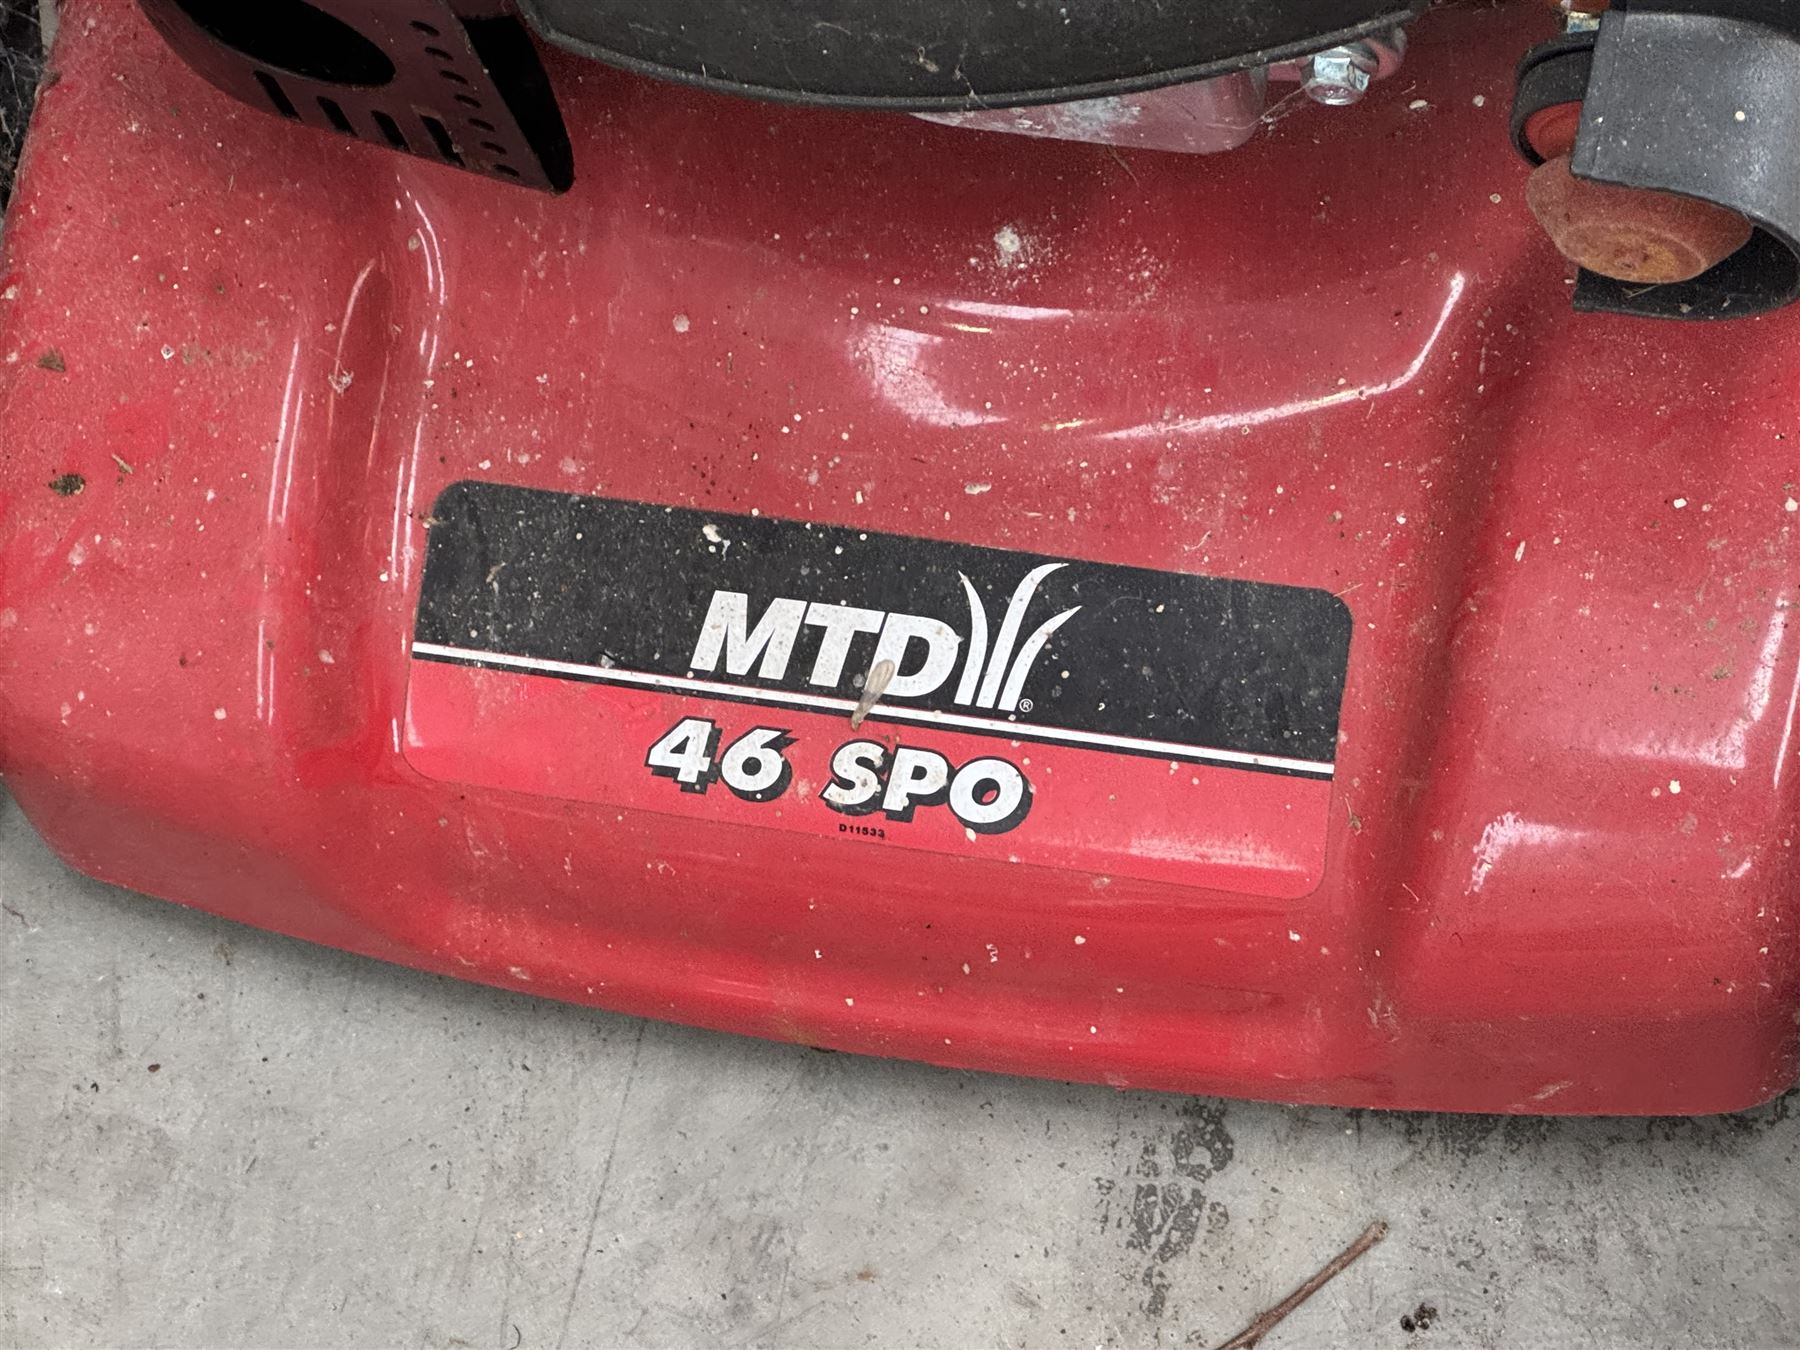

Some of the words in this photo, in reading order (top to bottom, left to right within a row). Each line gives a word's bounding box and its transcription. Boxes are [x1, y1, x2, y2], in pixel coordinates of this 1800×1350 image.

[690, 590, 960, 697] MTD
[645, 716, 798, 802] 46
[820, 739, 1033, 834] SPO
